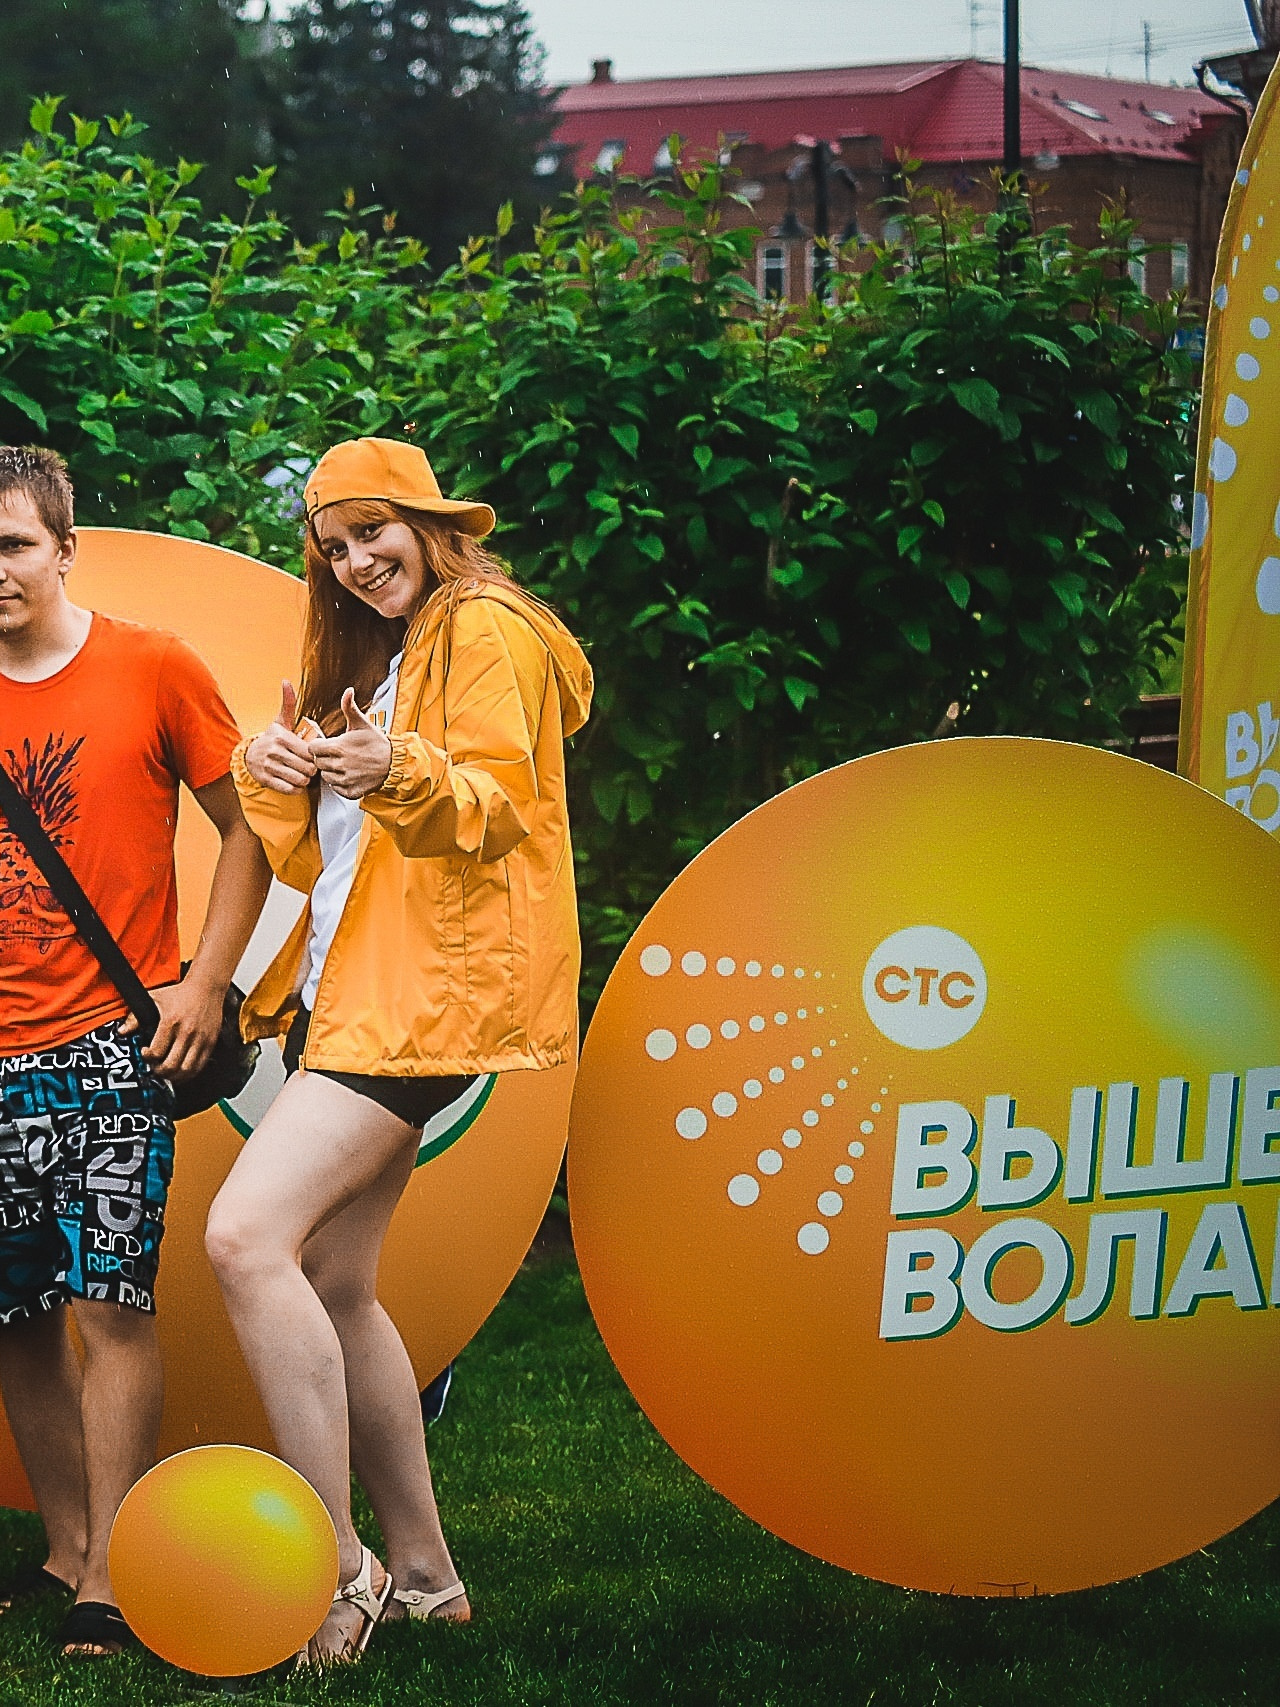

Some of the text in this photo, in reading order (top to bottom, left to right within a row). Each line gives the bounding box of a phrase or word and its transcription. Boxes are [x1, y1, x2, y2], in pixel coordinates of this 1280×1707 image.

[873, 965, 976, 1009] СТС
[889, 1066, 1280, 1221] ВЫШЕ
[878, 1200, 1280, 1342] ВОЛА
